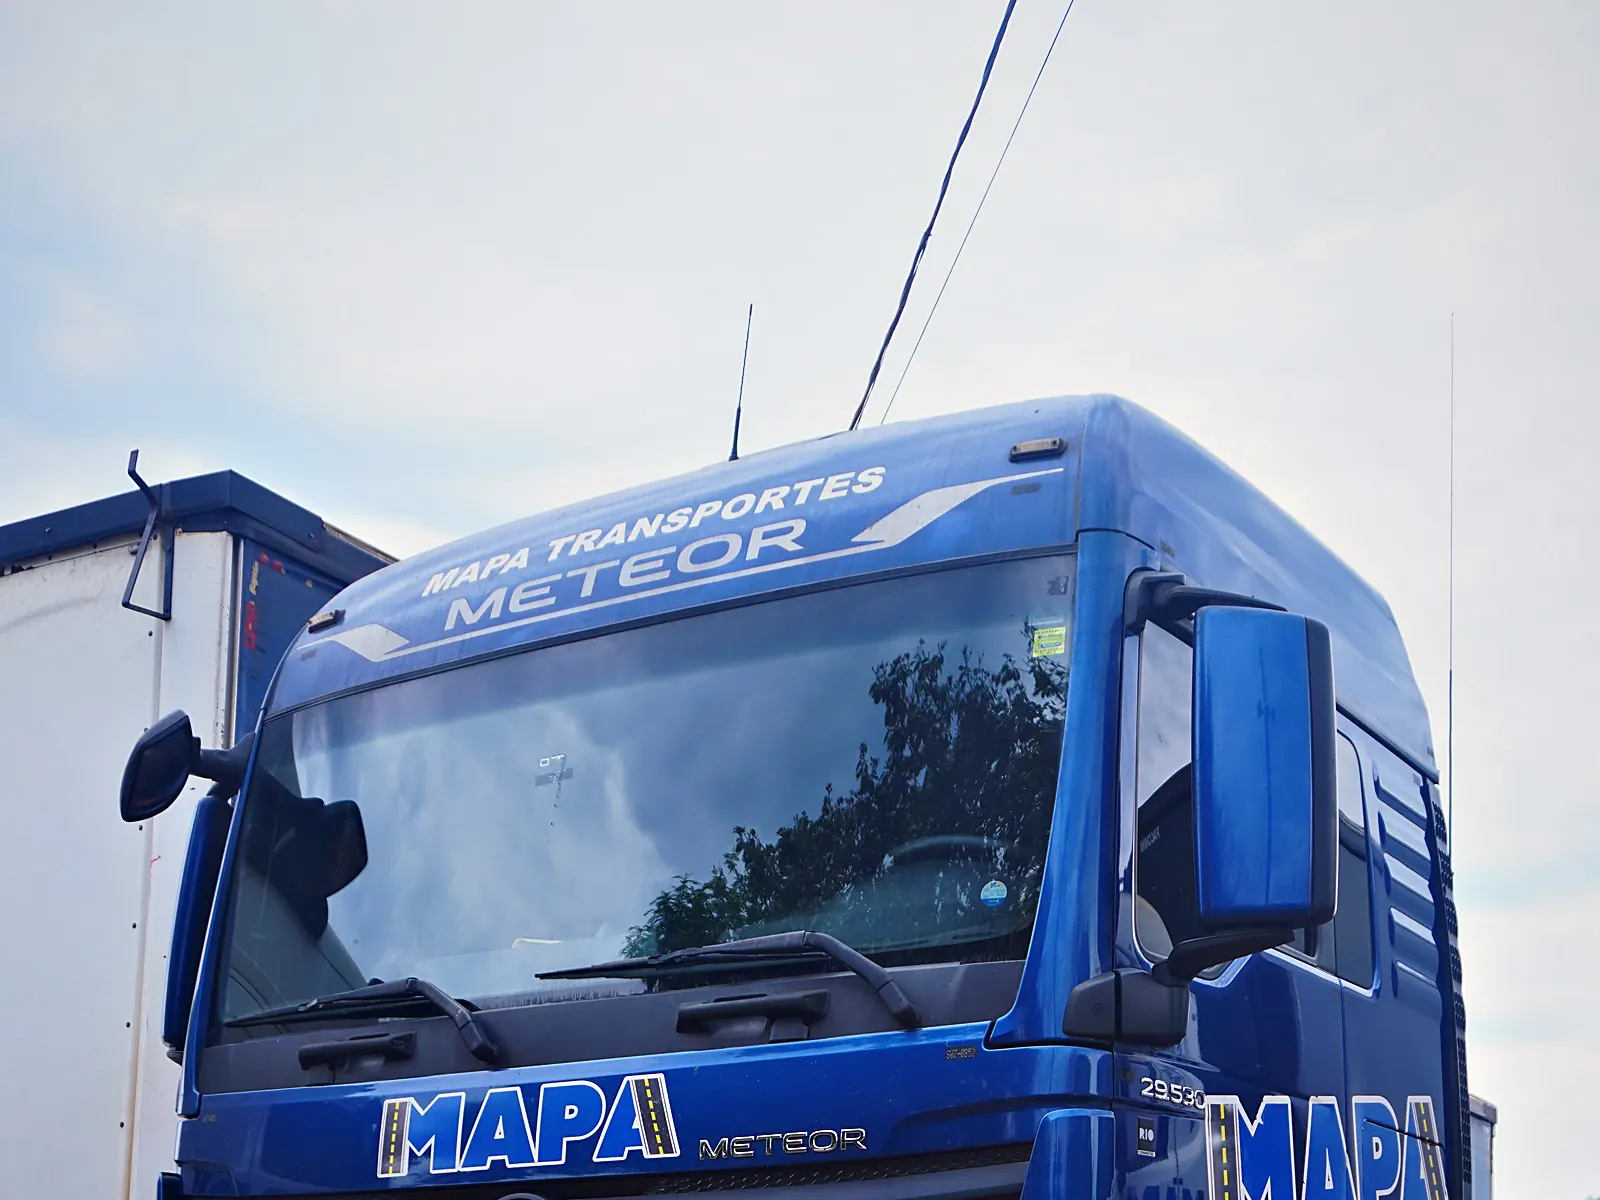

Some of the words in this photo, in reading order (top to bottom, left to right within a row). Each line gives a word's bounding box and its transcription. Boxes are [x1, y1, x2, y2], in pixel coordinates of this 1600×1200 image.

[421, 547, 530, 598] MAPA
[546, 465, 888, 563] TRANSPORTES
[443, 518, 808, 631] METEOR
[377, 1072, 681, 1179] MAPA
[1140, 1077, 1207, 1110] 29.530
[699, 1127, 867, 1161] METEOR
[1139, 1127, 1155, 1142] RIO
